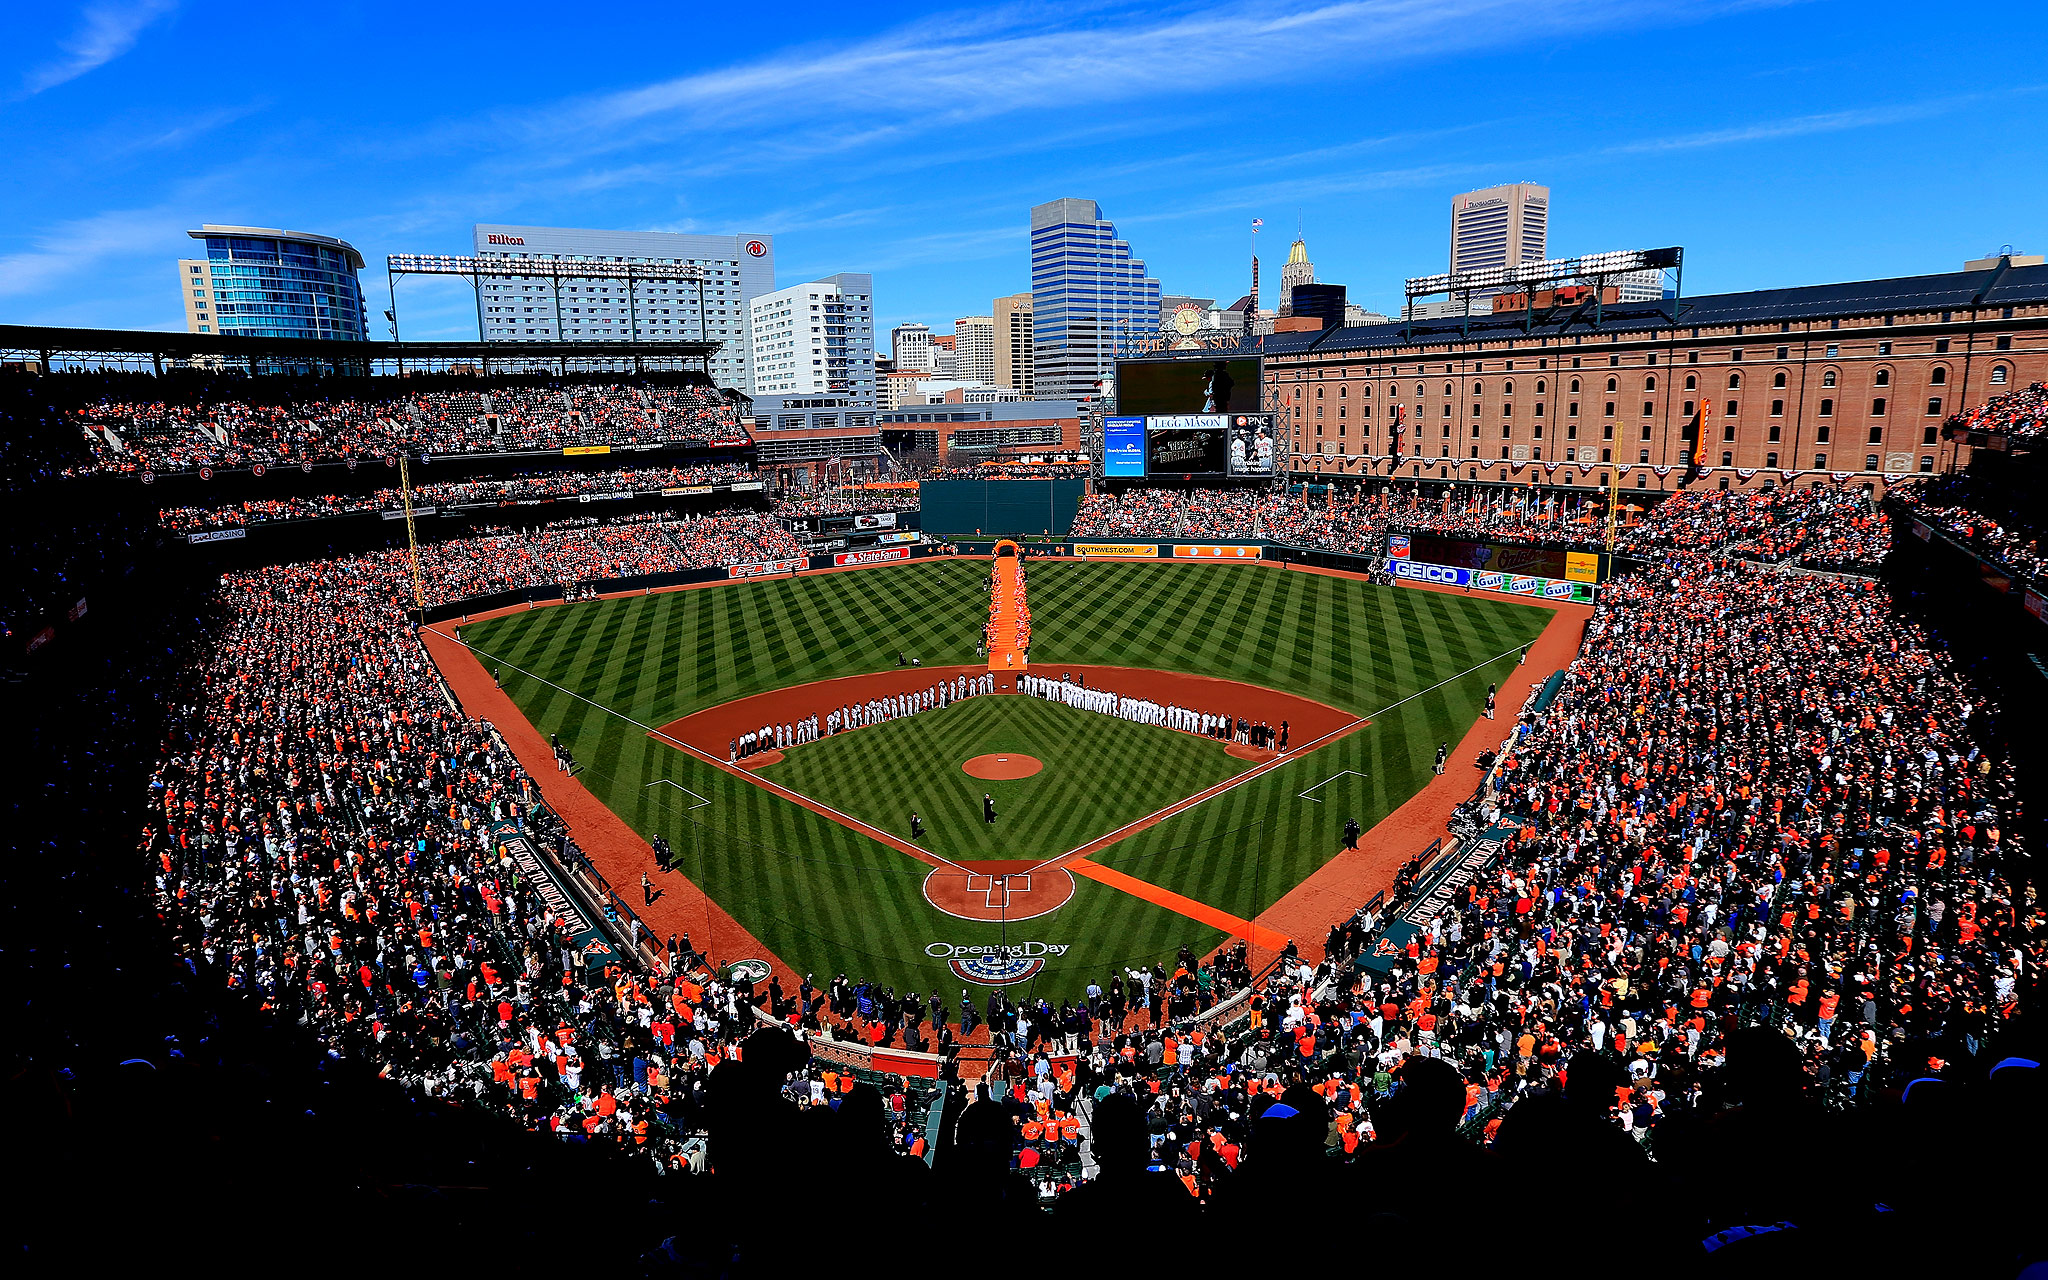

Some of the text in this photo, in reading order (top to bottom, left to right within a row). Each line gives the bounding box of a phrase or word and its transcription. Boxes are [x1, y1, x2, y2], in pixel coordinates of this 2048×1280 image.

[1468, 198, 1502, 209] TRANSAMERICA
[488, 234, 525, 246] Hilton
[1172, 303, 1202, 314] ORIOLES
[1136, 336, 1240, 351] THE SUN
[1155, 417, 1220, 428] LEGG MASON
[1247, 416, 1268, 425] PNC
[612, 491, 634, 499] UNION
[211, 530, 244, 539] CASINO
[1076, 546, 1134, 554] SOUTHWEST.COM
[1396, 562, 1458, 583] GEICO
[1478, 575, 1502, 586] Gulf
[1511, 580, 1536, 591] Gulf
[1545, 585, 1571, 595] Gulf
[506, 839, 587, 933] WELCOME TO ORIOLE PARK
[1408, 839, 1501, 923] HOME OF THE ORIOLES
[924, 941, 1071, 958] Opening Day
